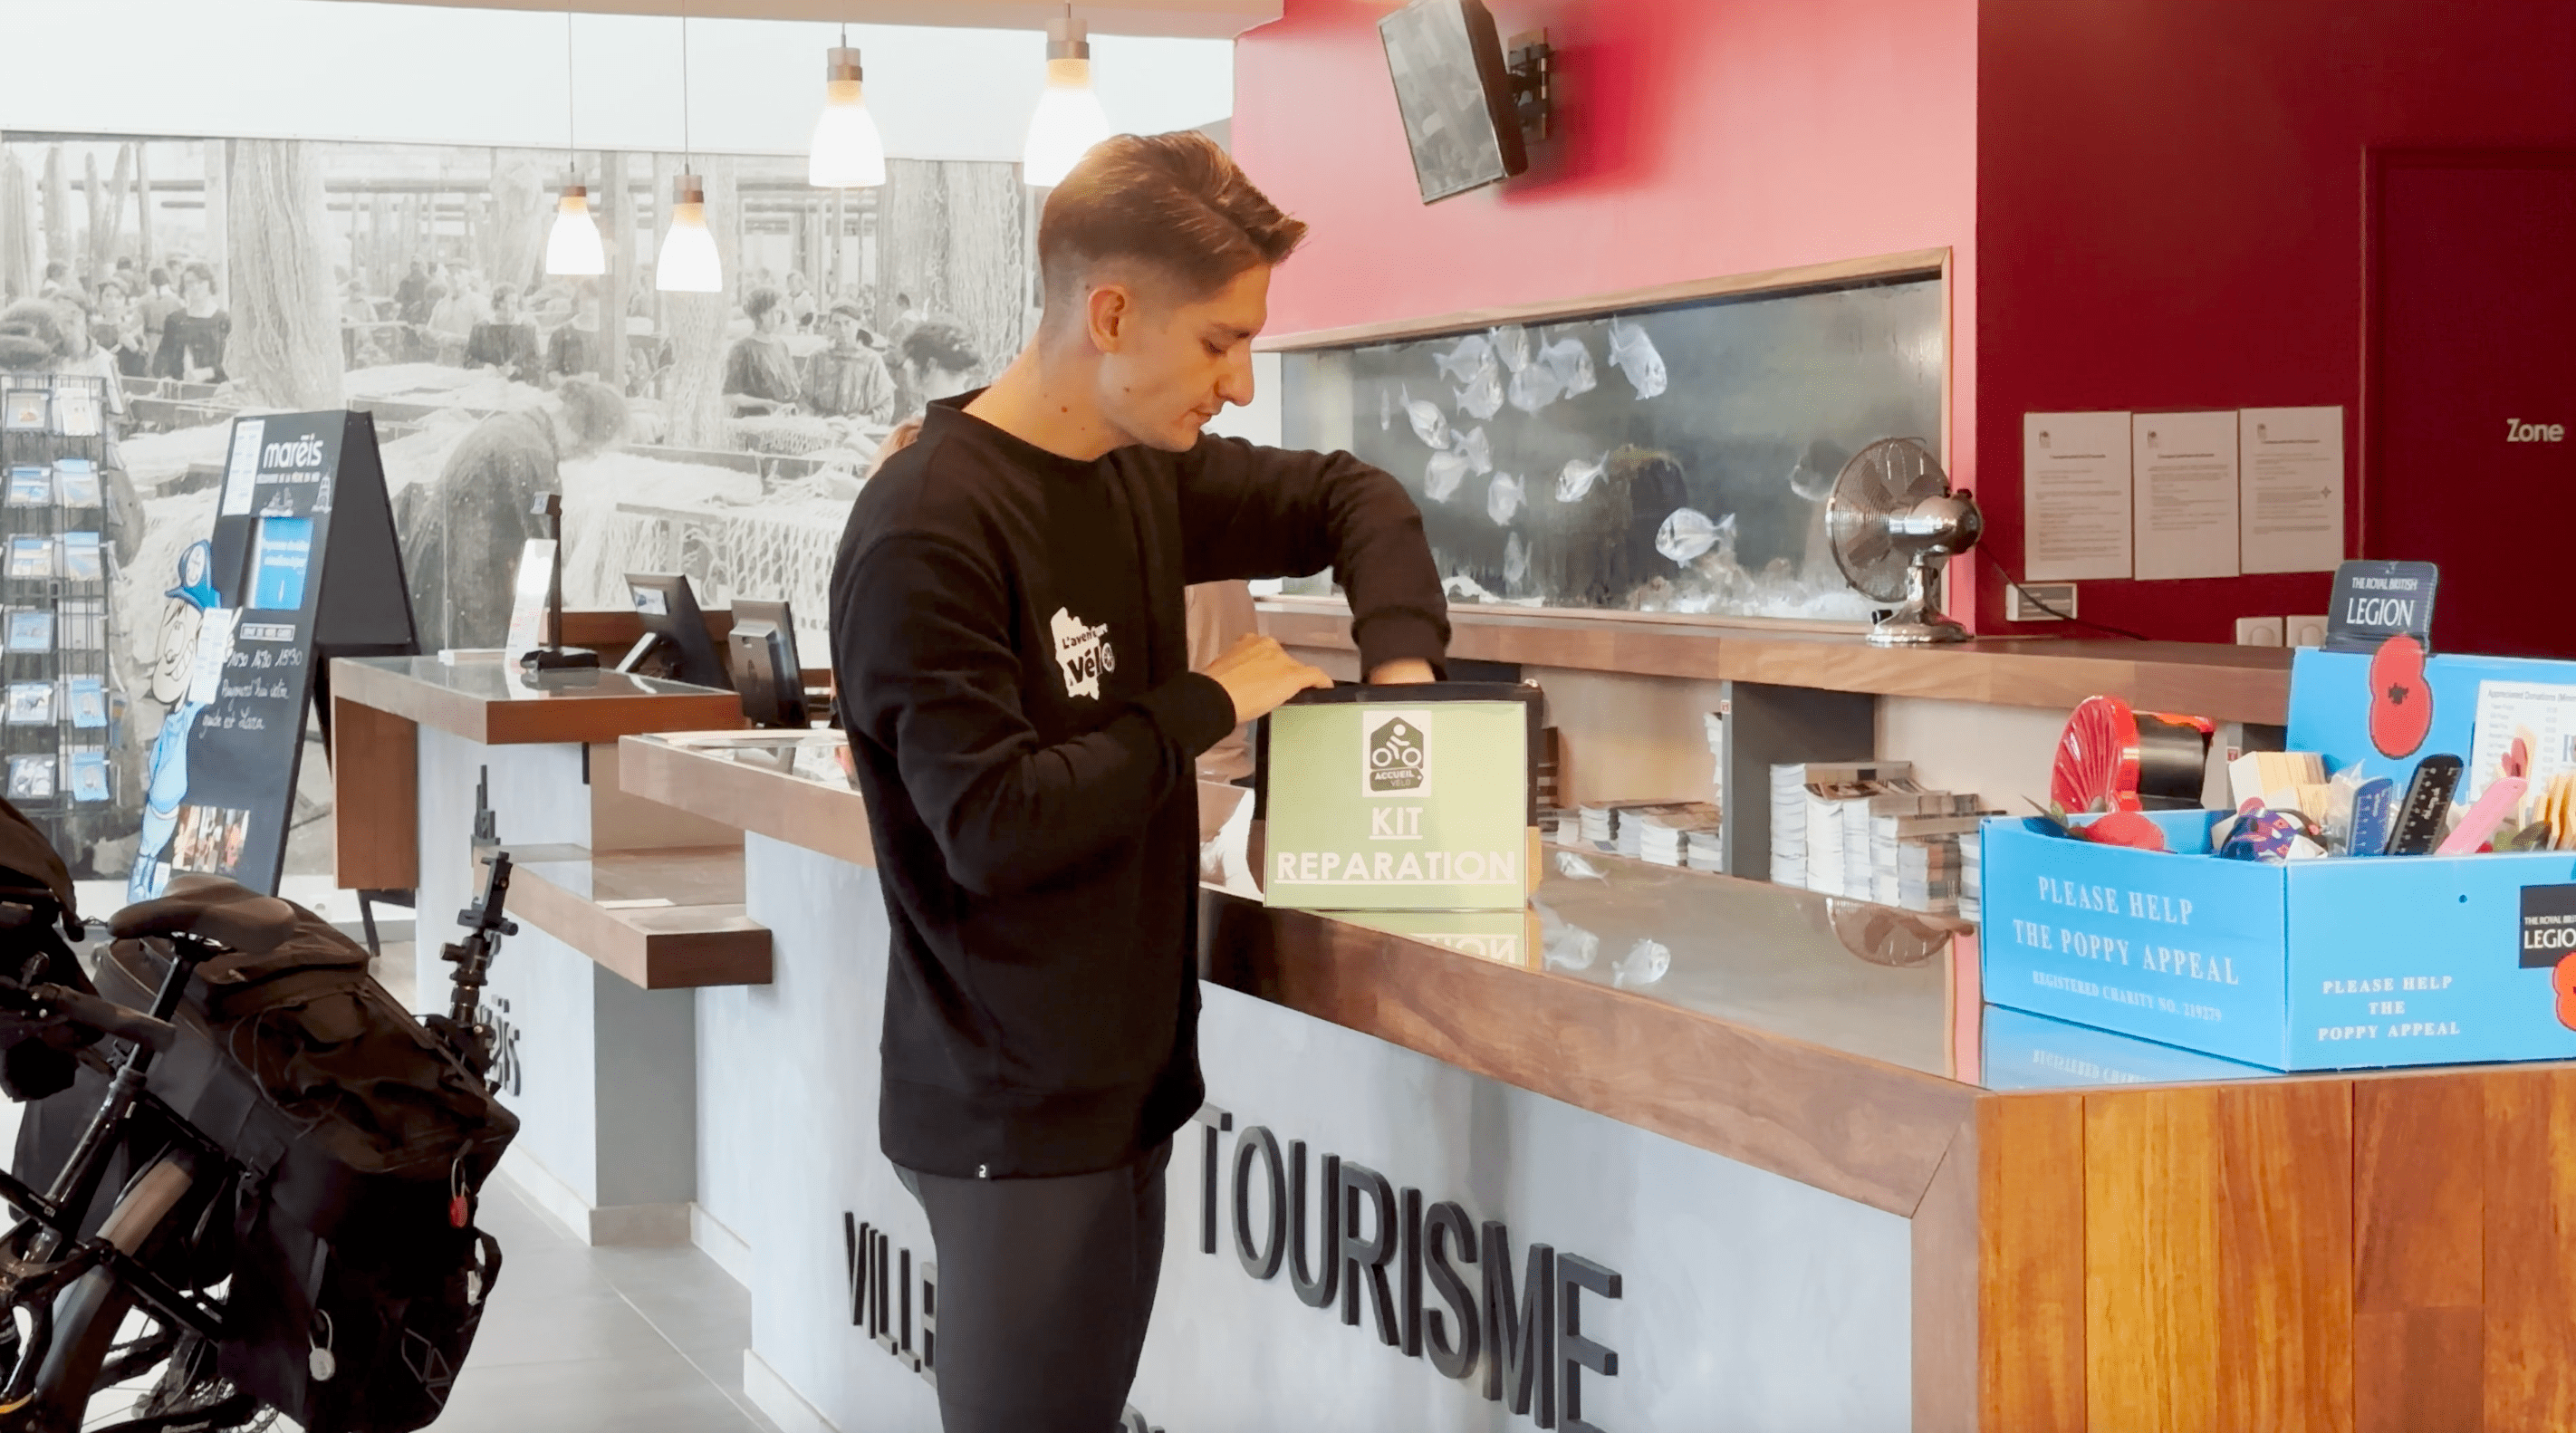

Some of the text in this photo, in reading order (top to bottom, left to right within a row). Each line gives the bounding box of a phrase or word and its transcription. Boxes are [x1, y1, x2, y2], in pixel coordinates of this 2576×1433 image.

[2506, 418, 2565, 442] Zone
[2352, 577, 2418, 591] THE ROYAL BRITISH
[2346, 597, 2417, 628] LEGION
[1374, 769, 1415, 780] ACCUEIL
[1371, 806, 1423, 835] KIT
[1277, 851, 1515, 880] REPARATION
[2039, 876, 2193, 925] PLEASE HELP
[2523, 928, 2576, 949] LEGIO
[2013, 918, 2239, 986] THE POPPY APPEAL
[2033, 970, 2100, 997] REGISTERED
[2102, 986, 2154, 1009] CHARITY
[2322, 975, 2453, 995] PLEASE HELP
[2368, 1001, 2406, 1015] THE
[2318, 1021, 2461, 1041] POPPY APPEAL
[1192, 1102, 1622, 1433] TOURISME
